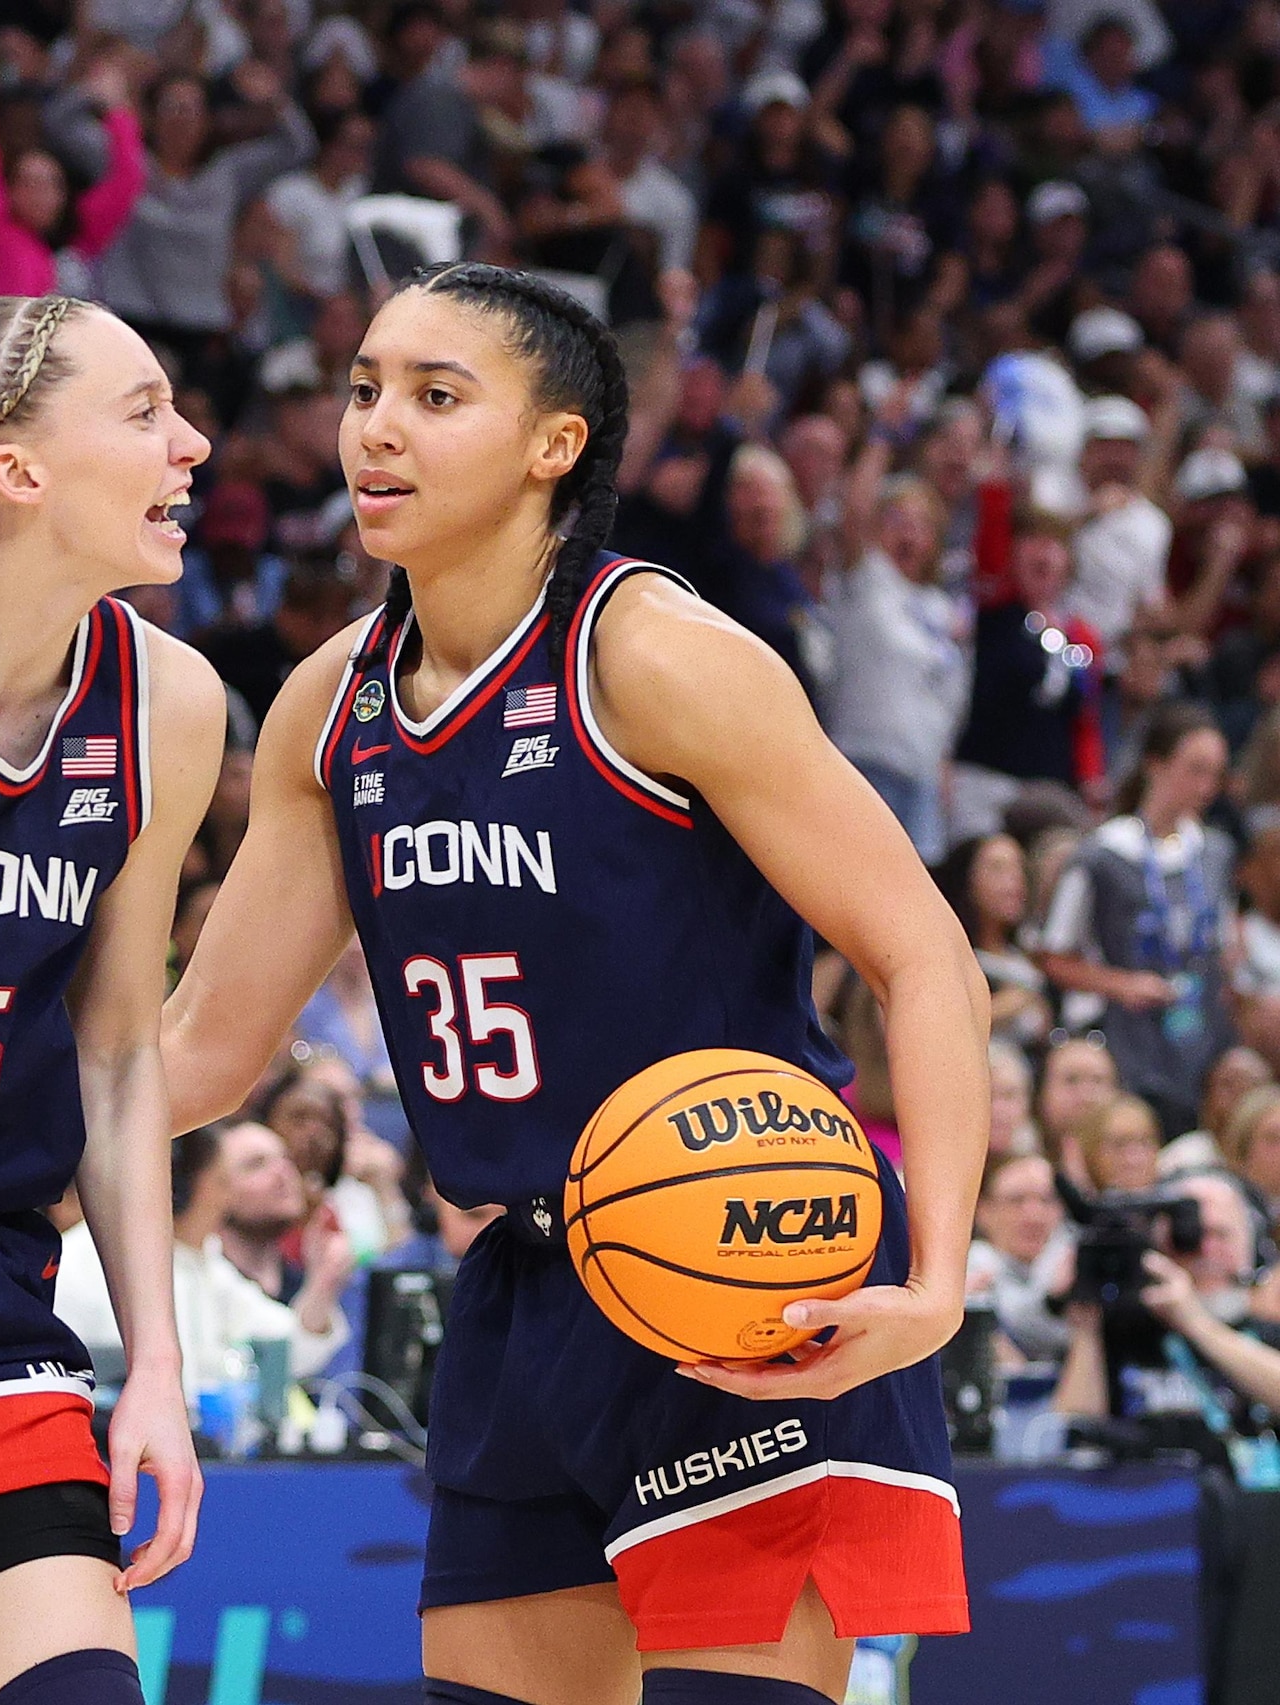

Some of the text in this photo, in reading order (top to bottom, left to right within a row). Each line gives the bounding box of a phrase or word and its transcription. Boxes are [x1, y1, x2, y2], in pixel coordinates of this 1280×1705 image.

[511, 734, 551, 754] BIG
[505, 746, 560, 769] EAST
[360, 773, 384, 789] THE
[69, 788, 110, 803] BIG
[63, 802, 119, 818] EAST
[402, 951, 542, 1103] 35
[667, 1090, 862, 1152] Wilson
[757, 1136, 816, 1147] EVO NXT
[720, 1193, 858, 1244] NCAA
[717, 1245, 855, 1257] OFFICIAL GAME BALL
[635, 1418, 809, 1505] HUSKIES
